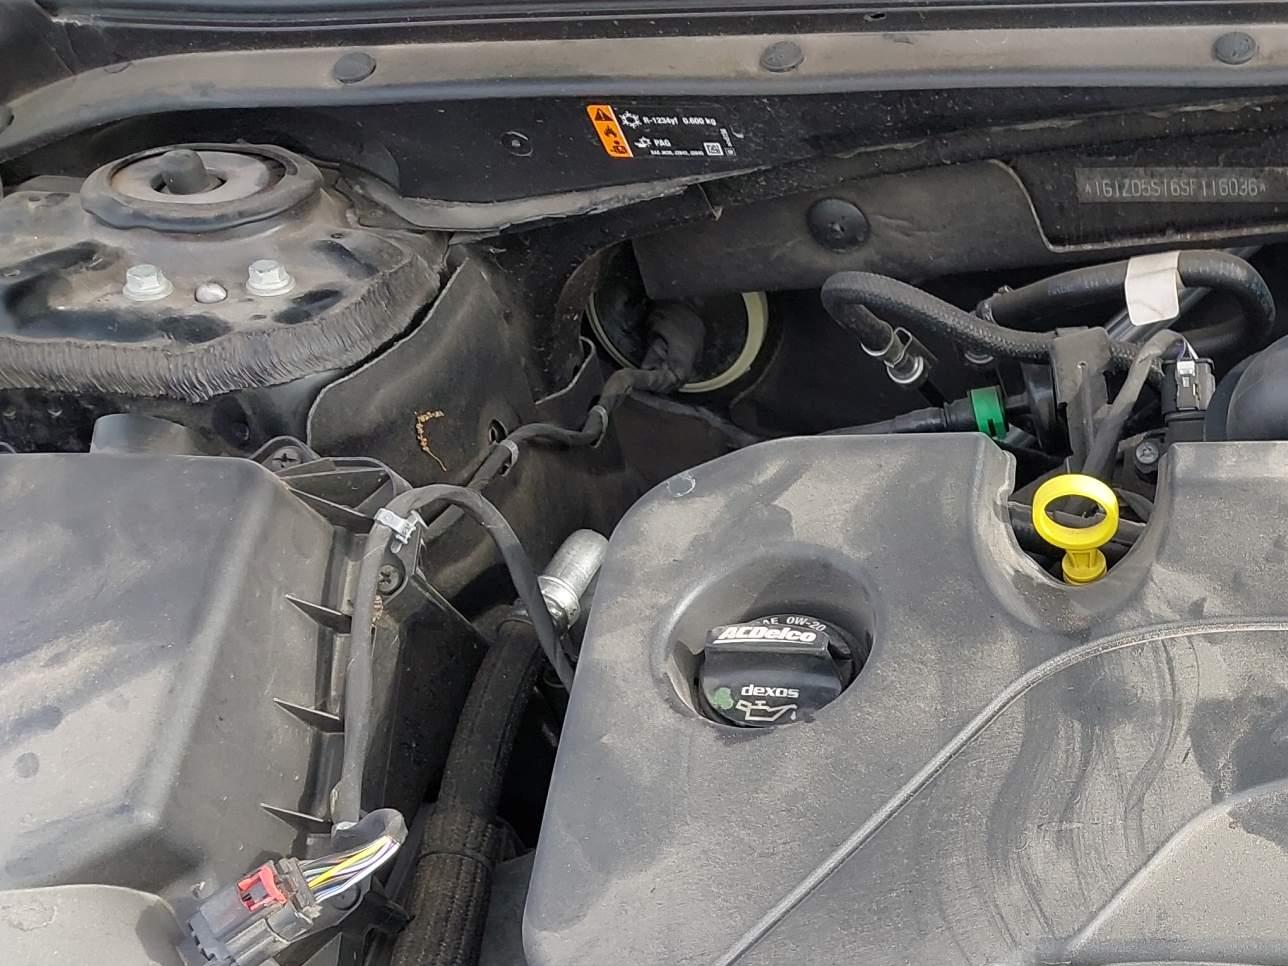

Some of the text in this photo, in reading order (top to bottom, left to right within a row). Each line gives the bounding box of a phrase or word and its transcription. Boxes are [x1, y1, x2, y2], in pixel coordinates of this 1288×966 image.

[682, 117, 704, 125] 0.600
[706, 118, 717, 126] kg
[654, 139, 671, 147] PAG
[786, 616, 827, 632] 0W-20
[718, 626, 817, 642] ACDelco
[741, 684, 799, 698] dexos
